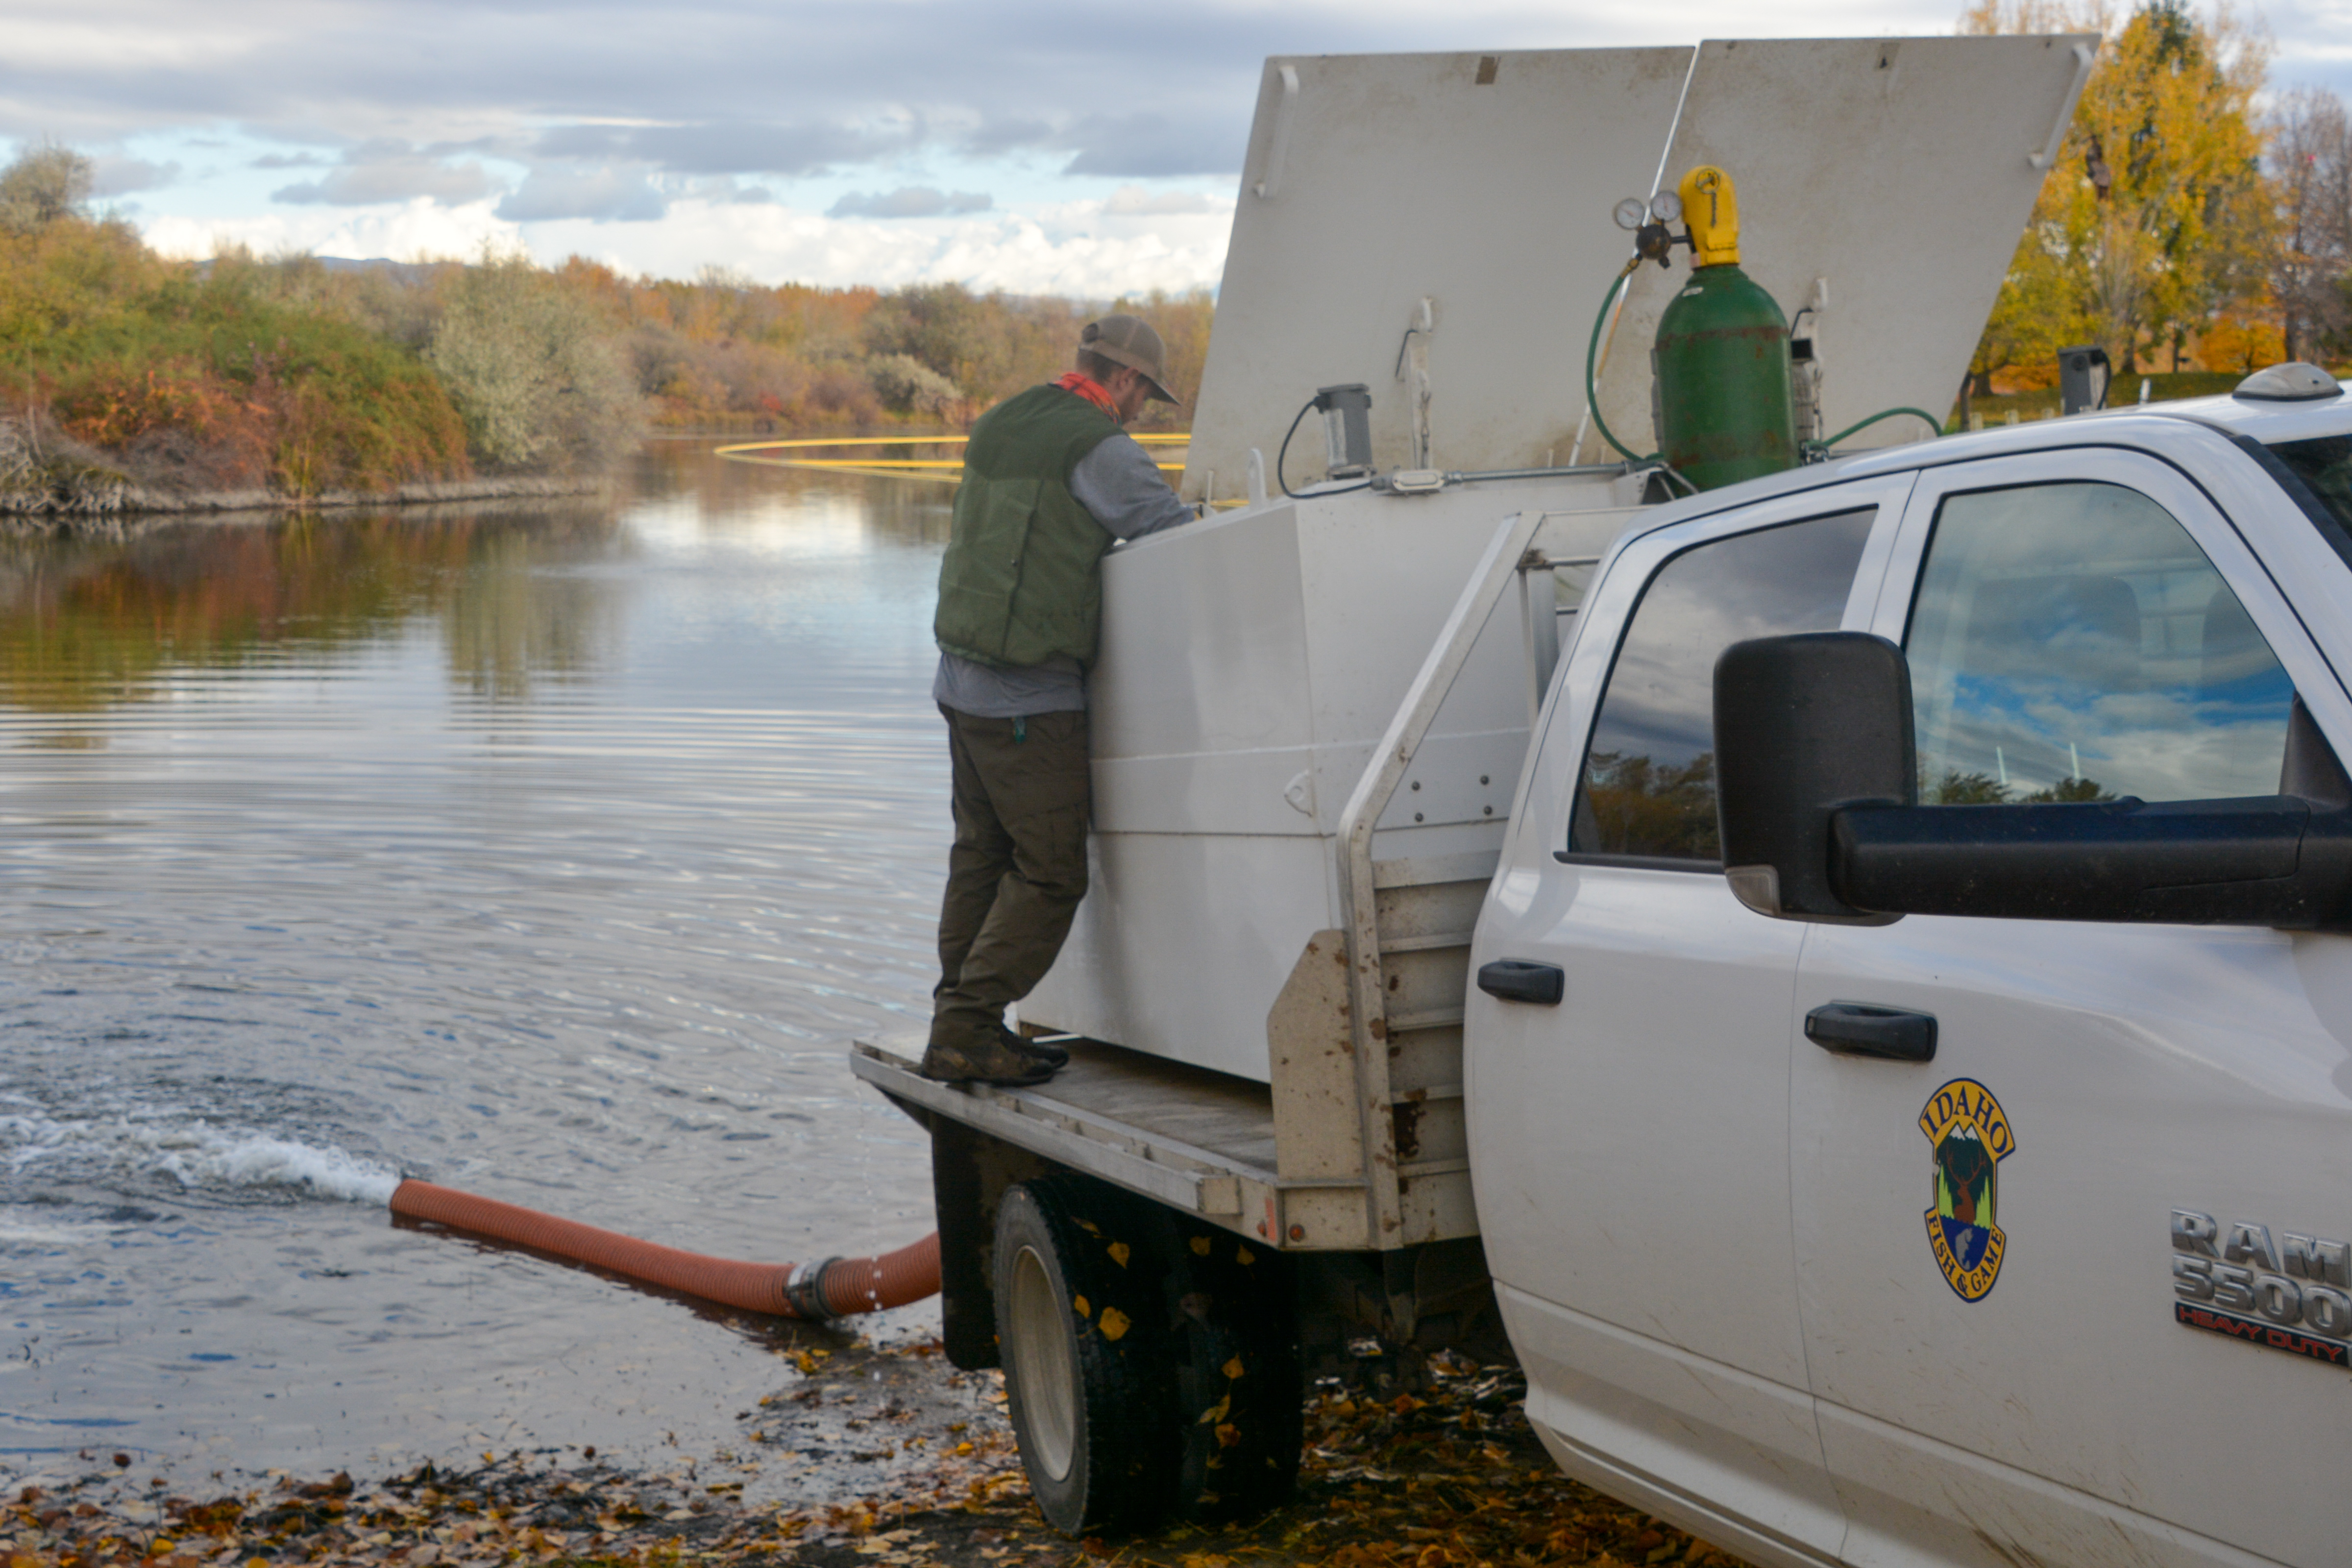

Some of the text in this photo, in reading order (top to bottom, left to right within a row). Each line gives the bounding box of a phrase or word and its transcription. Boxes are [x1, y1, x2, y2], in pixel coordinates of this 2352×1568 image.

[1922, 1085, 2008, 1154] IDAHO
[1927, 1215, 2003, 1297] FISH & GAME
[2171, 1205, 2352, 1289] RAM
[2173, 1253, 2352, 1337] 5500
[2179, 1305, 2343, 1361] HEAVY DUTY
